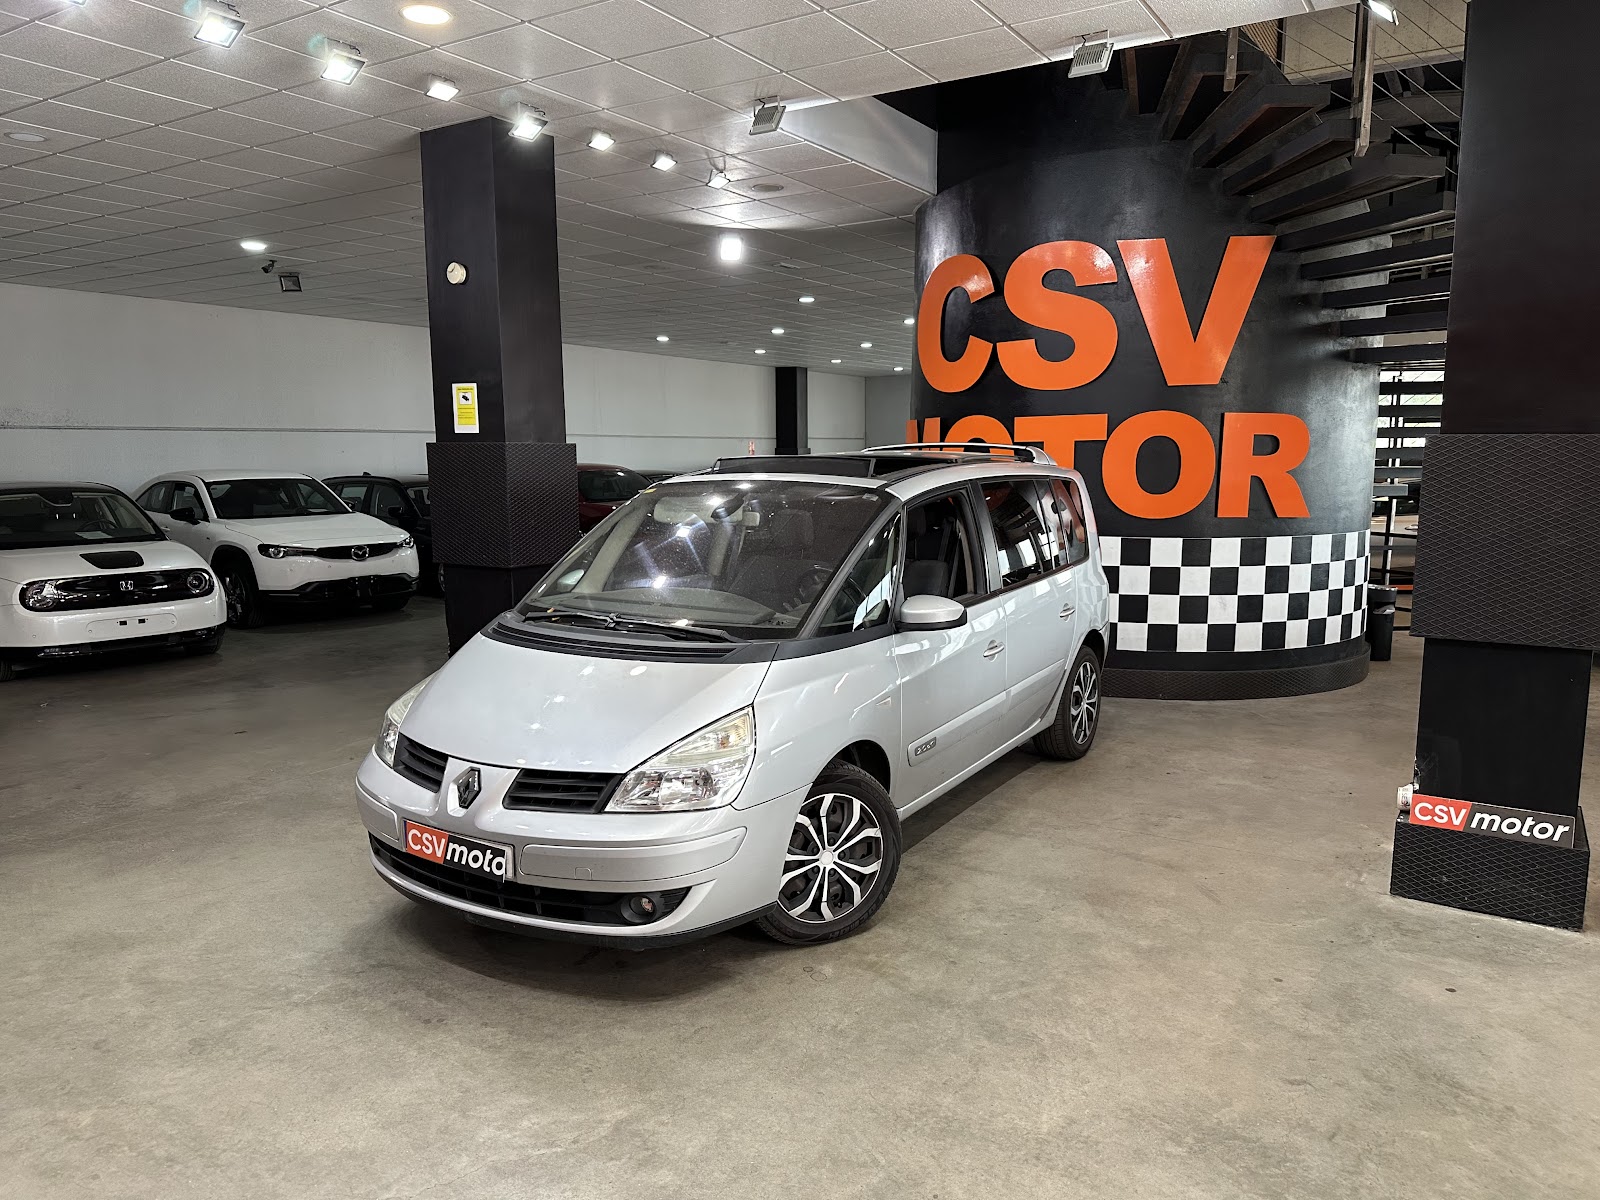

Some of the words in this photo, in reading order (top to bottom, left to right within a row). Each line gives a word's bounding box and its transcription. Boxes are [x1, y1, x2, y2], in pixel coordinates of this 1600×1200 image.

[917, 235, 1277, 393] CSV
[1414, 802, 1467, 826] CSV
[1470, 812, 1570, 841] motor
[408, 829, 446, 858] CSV
[446, 842, 506, 877] moto
